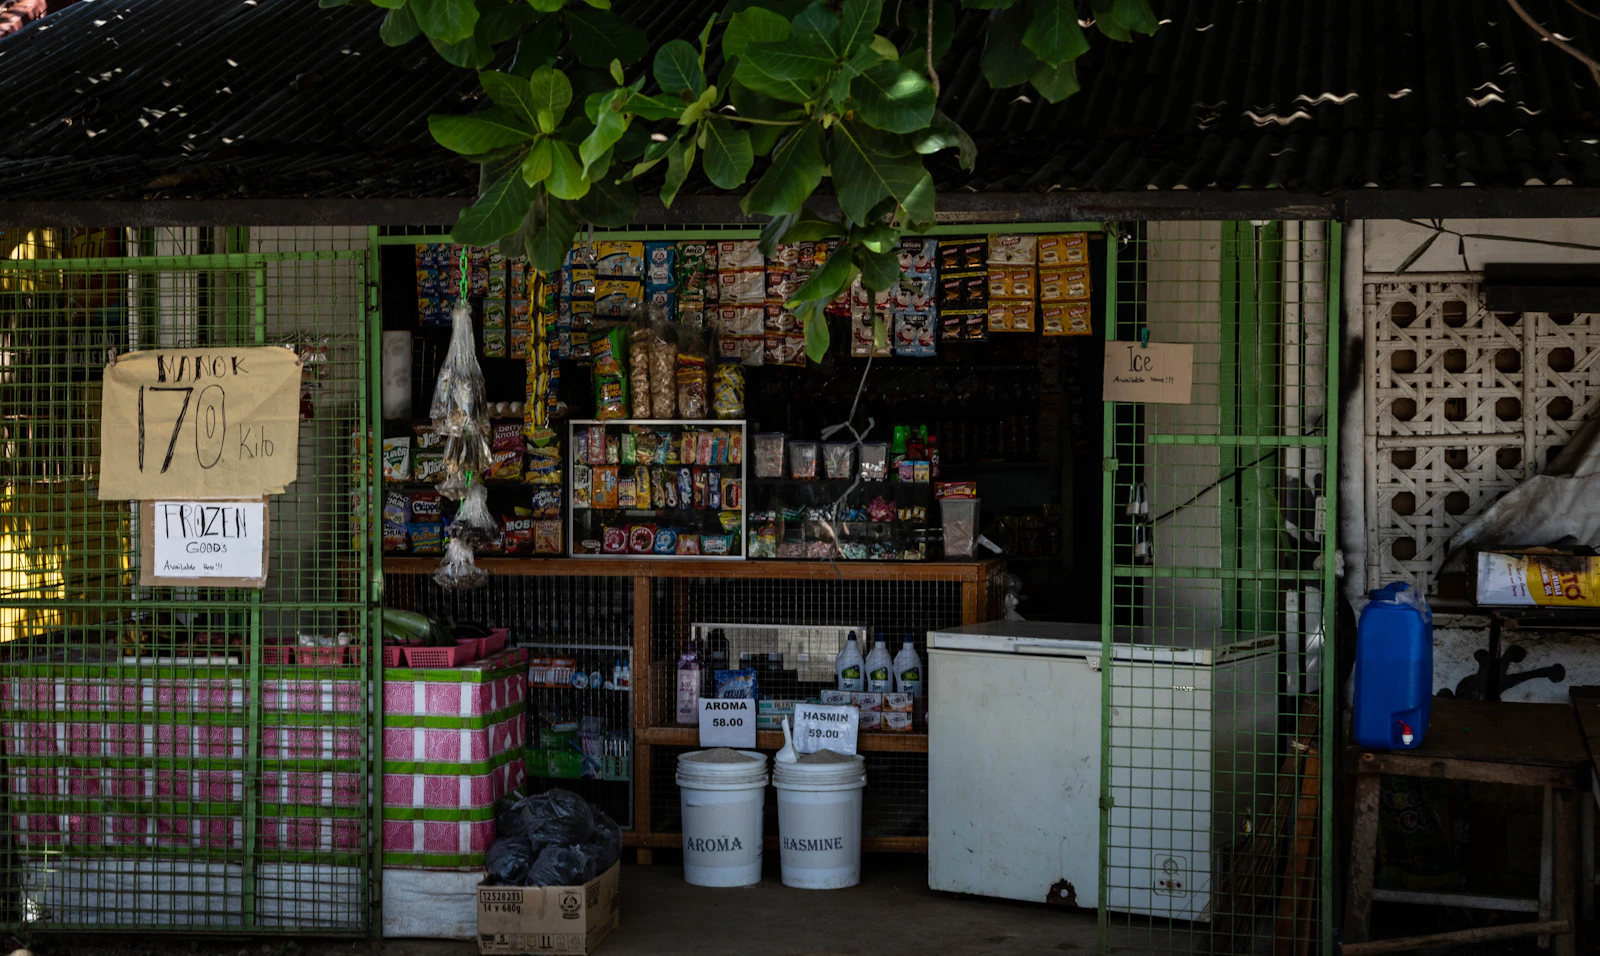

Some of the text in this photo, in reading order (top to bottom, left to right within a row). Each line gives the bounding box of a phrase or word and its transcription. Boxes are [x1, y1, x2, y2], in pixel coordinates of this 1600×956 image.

[1127, 345, 1154, 372] Ice
[157, 354, 249, 383] MANOK
[499, 425, 522, 433] berry
[495, 431, 520, 439] knots
[239, 423, 274, 460] Kilo
[158, 504, 247, 538] FROZEN
[163, 560, 196, 571] Available
[705, 702, 747, 710] AROMA
[713, 718, 743, 726] 58.00
[803, 712, 849, 722] HASMIN
[809, 729, 839, 738] 59.00
[687, 837, 743, 852] AROMA
[783, 837, 843, 851] HASMINE
[483, 892, 520, 901] 12528213
[484, 904, 492, 912] 14
[502, 904, 521, 914] 680g
